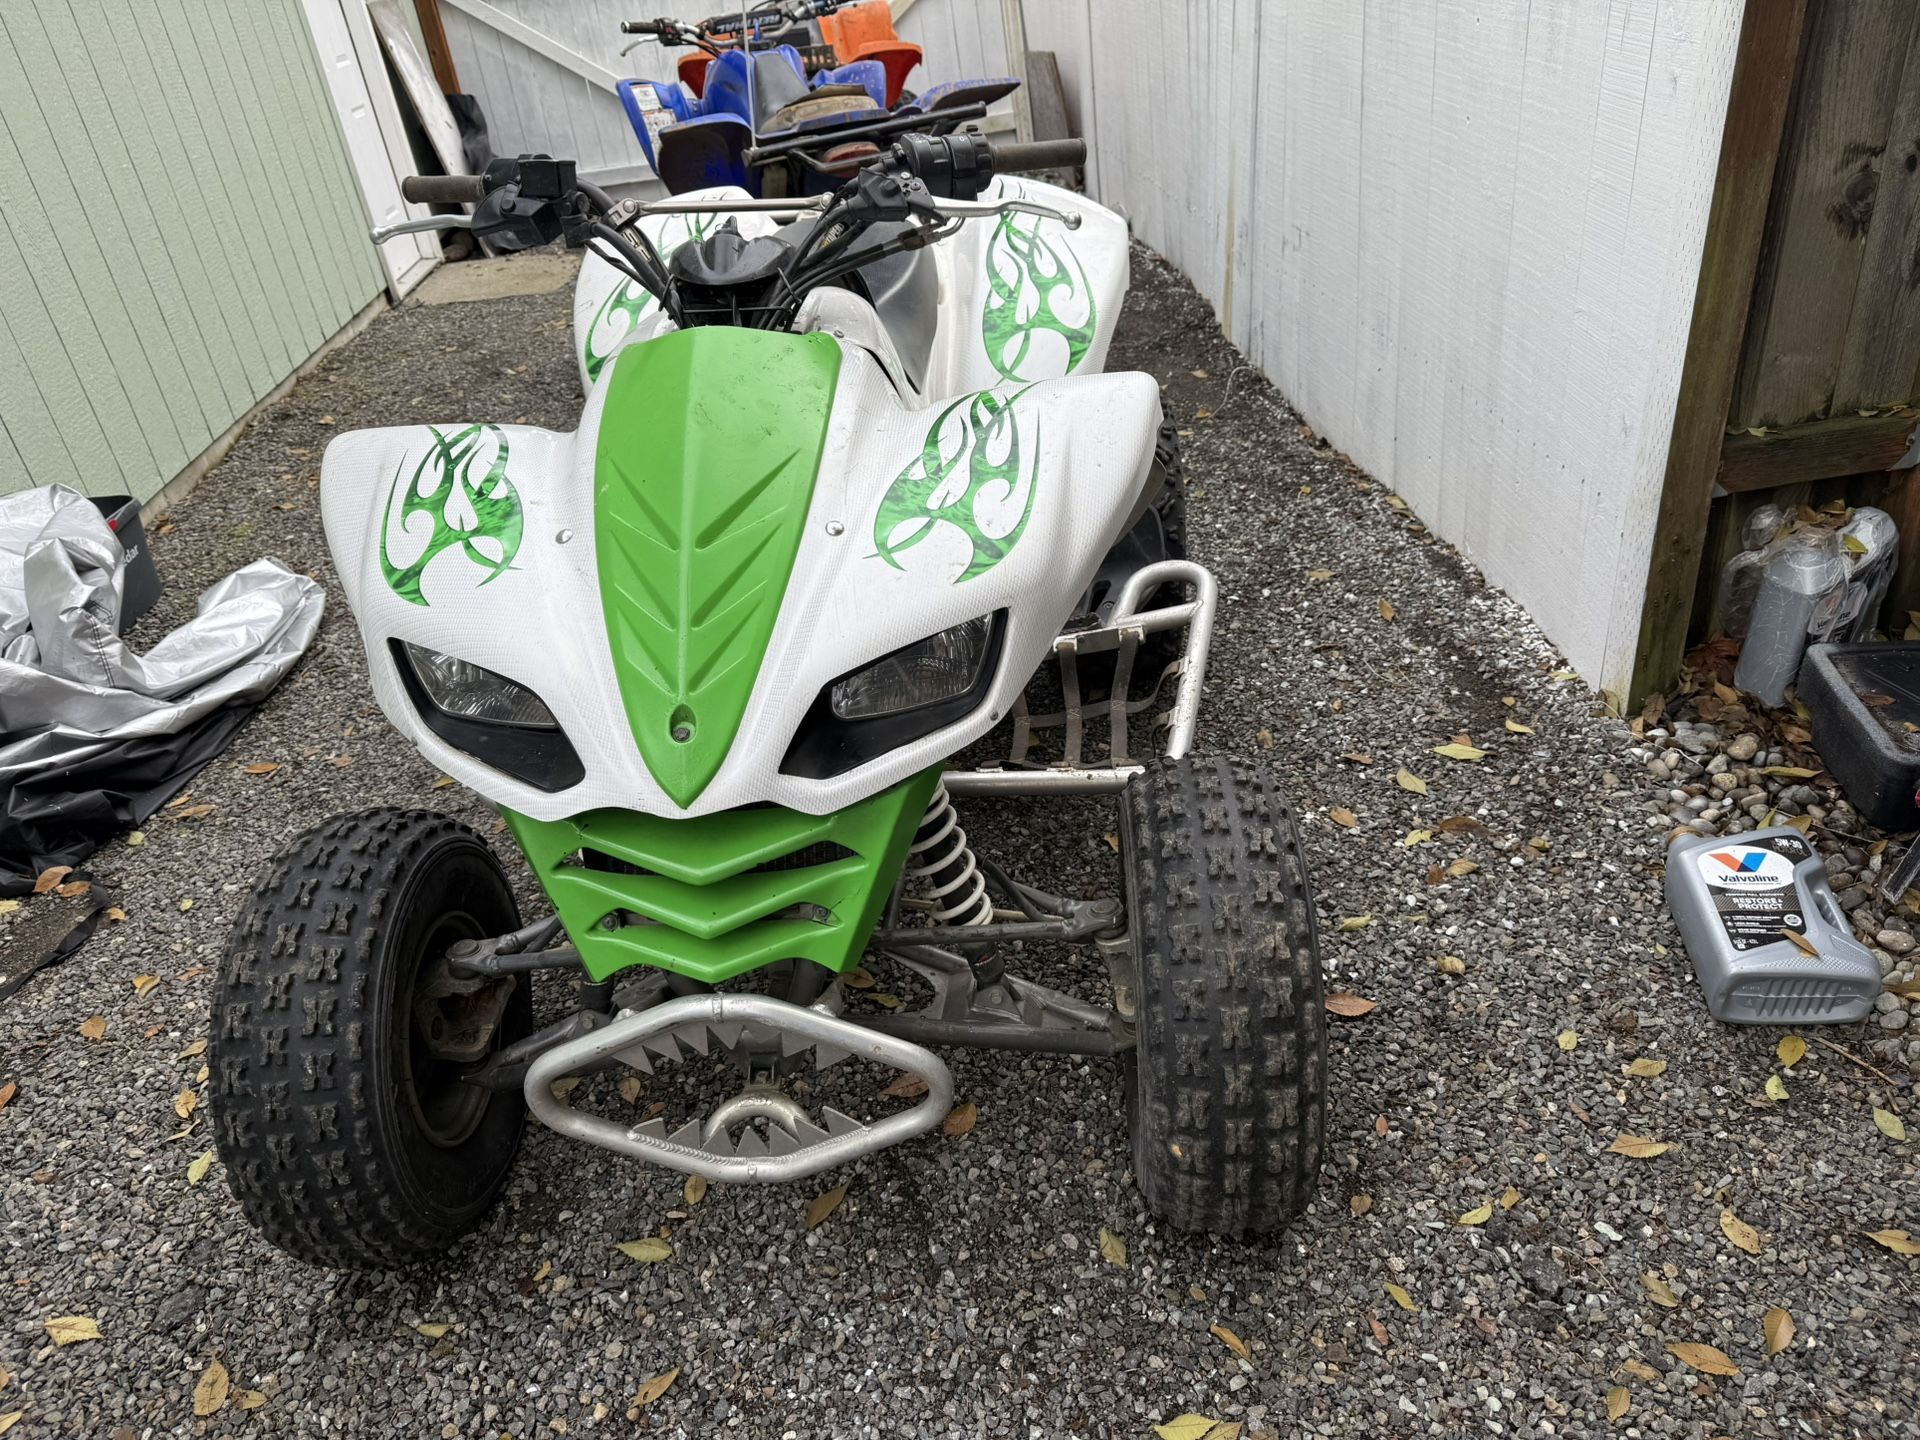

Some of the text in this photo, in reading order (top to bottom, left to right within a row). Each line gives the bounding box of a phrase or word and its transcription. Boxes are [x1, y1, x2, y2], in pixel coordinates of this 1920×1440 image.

[1774, 838, 1803, 849] 5W-30
[1718, 874, 1779, 883] Valvoline
[1732, 897, 1777, 905] RESTORE
